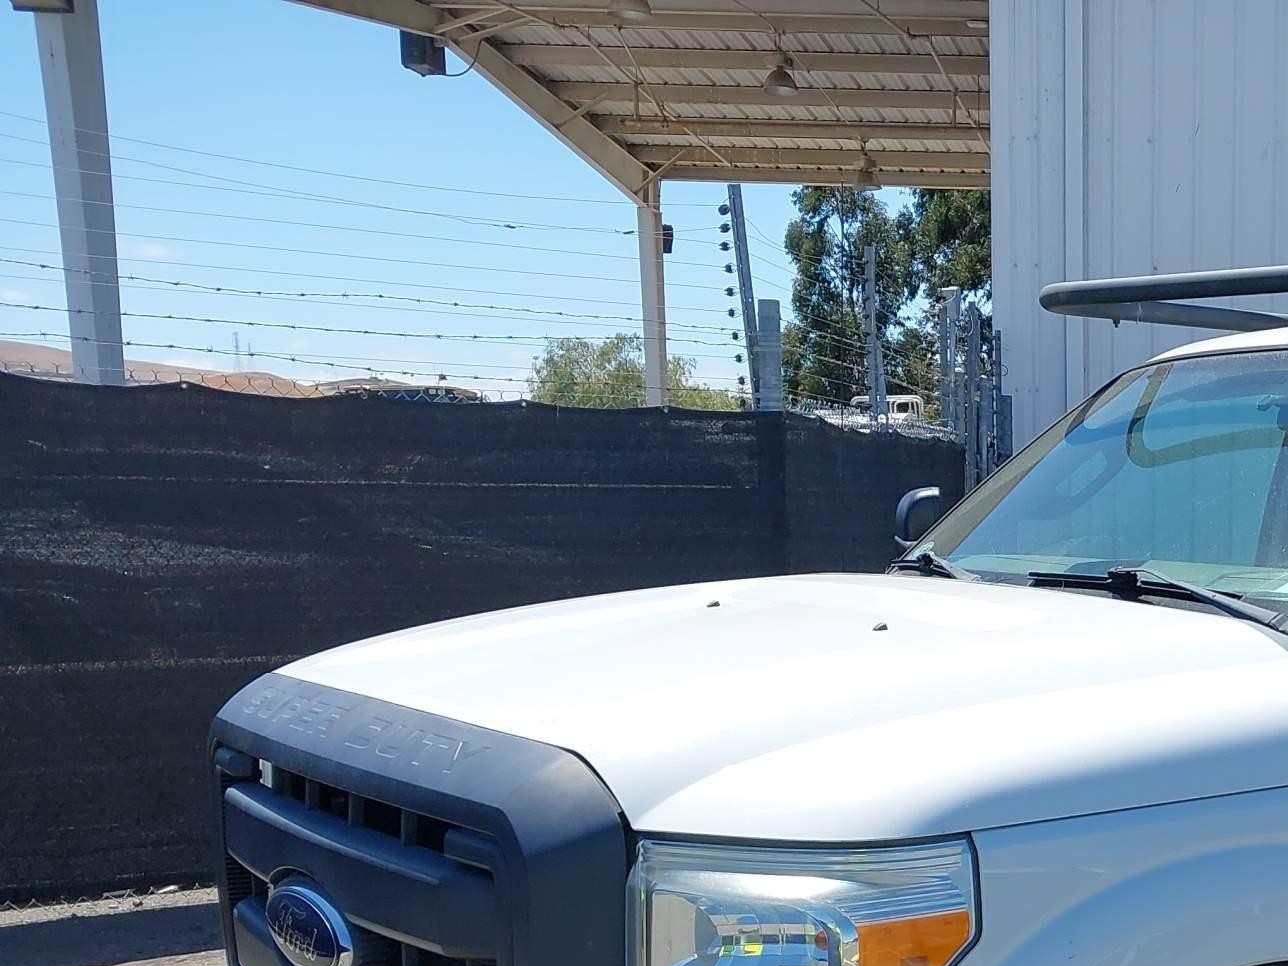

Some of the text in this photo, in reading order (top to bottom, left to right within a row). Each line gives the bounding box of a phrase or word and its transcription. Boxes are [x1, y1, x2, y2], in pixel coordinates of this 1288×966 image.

[242, 686, 494, 774] SUPER DUTY
[275, 902, 318, 961] Ford
